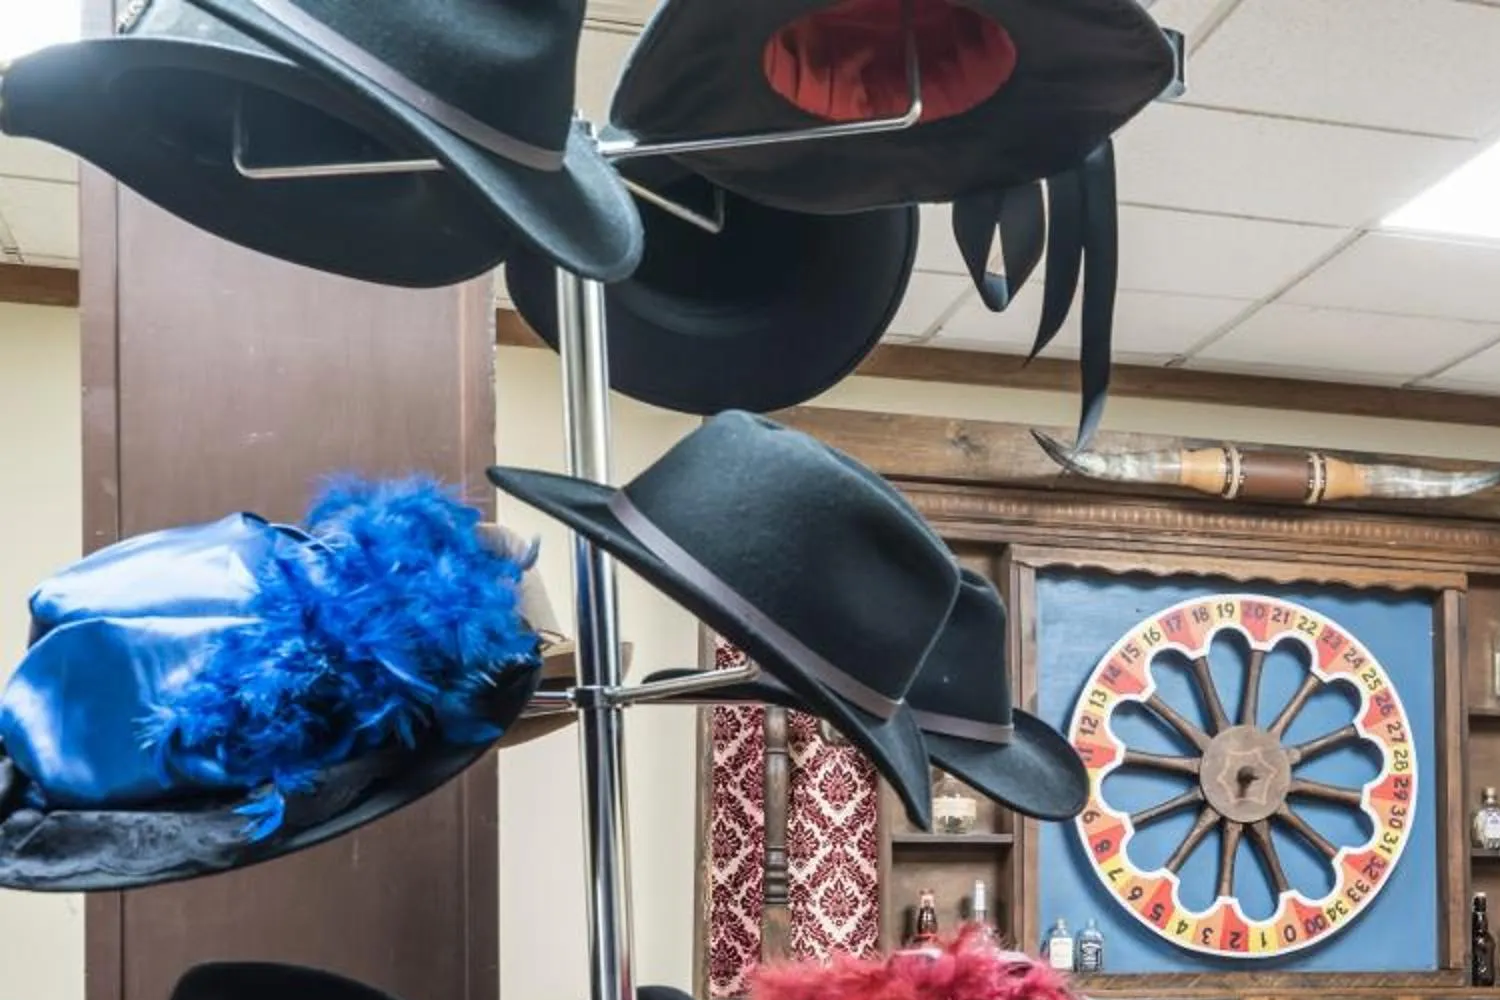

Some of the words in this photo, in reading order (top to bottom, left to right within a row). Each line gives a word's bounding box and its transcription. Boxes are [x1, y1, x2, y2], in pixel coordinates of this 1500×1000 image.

[1192, 606, 1210, 623] 18
[1217, 602, 1235, 618] 19
[1243, 604, 1265, 619] 20
[1272, 607, 1290, 624] 21
[1166, 614, 1181, 632] 17
[1297, 615, 1318, 636] 22
[1143, 627, 1160, 646] 16
[1322, 628, 1342, 649] 23
[1121, 643, 1140, 664] 15
[1343, 647, 1365, 669] 24
[1101, 663, 1121, 685] 14
[1361, 667, 1381, 690] 25
[1090, 688, 1107, 708] 13
[1375, 691, 1394, 716] 26
[1079, 716, 1099, 735] 12
[1388, 720, 1405, 744] 27
[1394, 749, 1409, 772] 28
[1393, 777, 1409, 800] 29
[1389, 804, 1406, 829] 30
[1094, 839, 1112, 853] 8
[1379, 832, 1399, 854] 31
[1107, 867, 1124, 882] 7
[1363, 857, 1386, 880] 32
[1347, 880, 1370, 902] 33
[1149, 903, 1165, 921] 5
[1327, 900, 1349, 922] 34
[1176, 920, 1188, 935] 4
[1284, 924, 1296, 942] 0
[1304, 914, 1328, 935] 00
[1202, 927, 1213, 945] 3
[1230, 931, 1241, 949] 2
[1261, 932, 1267, 948] 1
